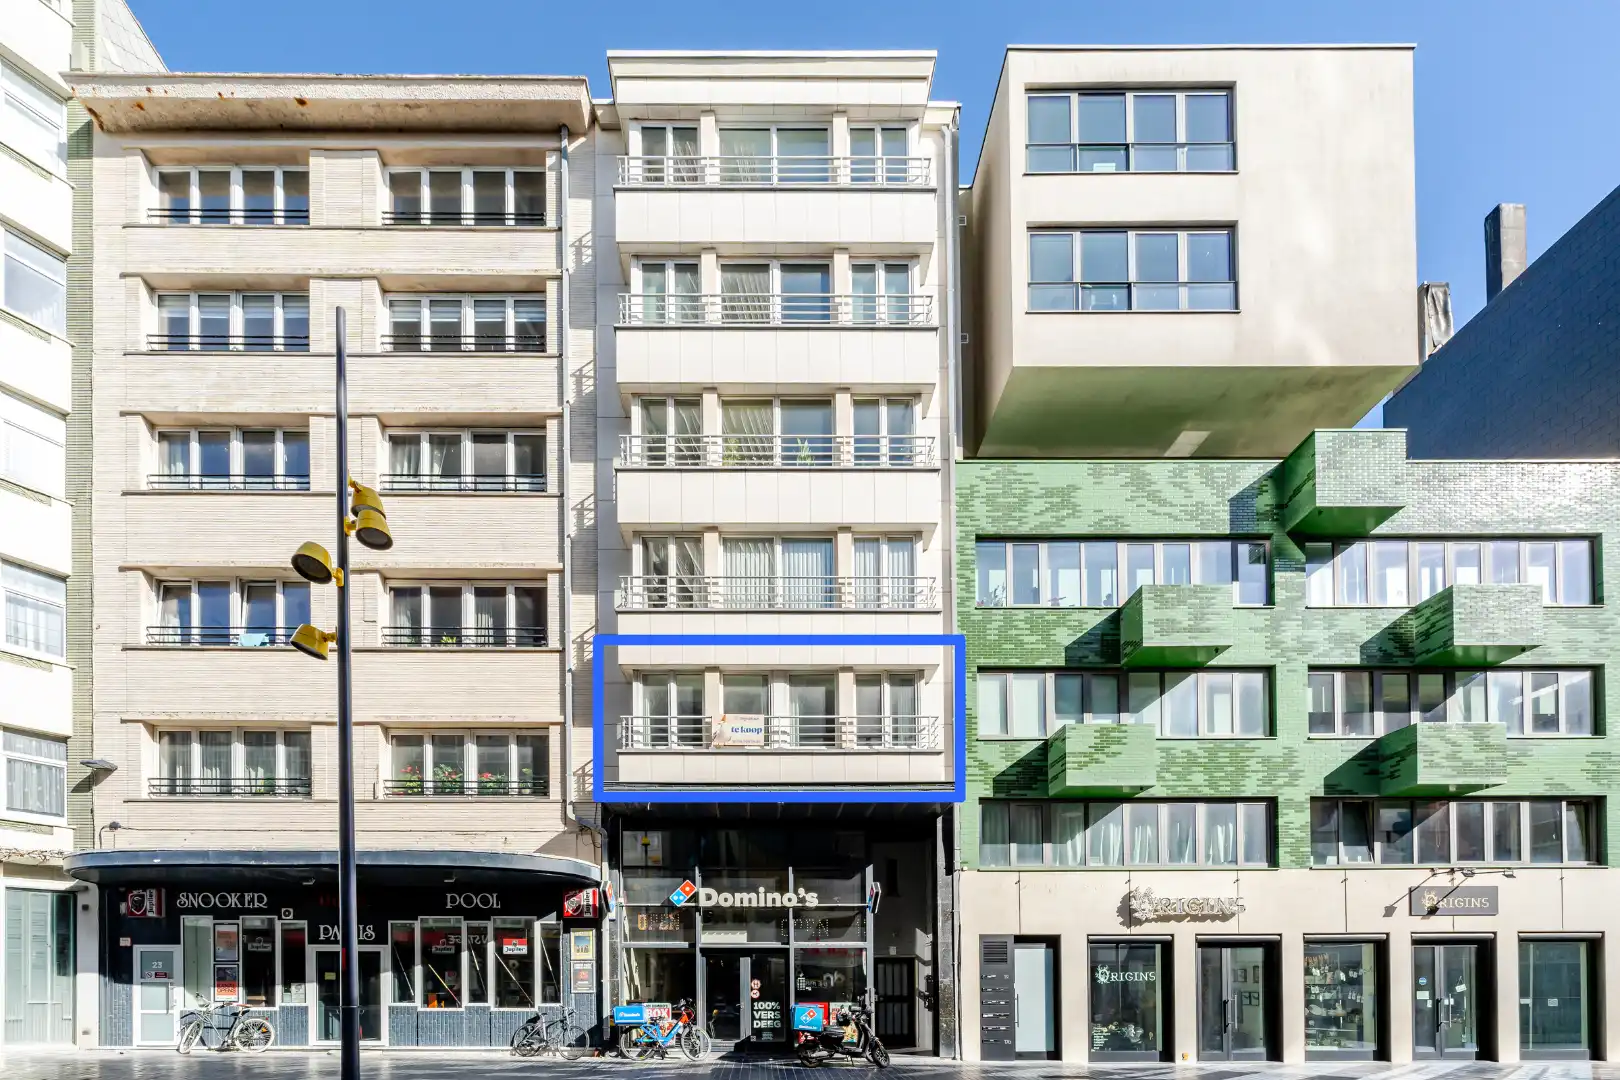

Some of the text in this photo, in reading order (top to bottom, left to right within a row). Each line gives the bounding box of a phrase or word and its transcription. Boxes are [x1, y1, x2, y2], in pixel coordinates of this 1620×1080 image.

[740, 725, 763, 735] koop
[147, 889, 155, 915] Jupiler
[176, 892, 268, 909] SNOOKER
[445, 892, 501, 909] POOL
[584, 890, 592, 916] Jupiler
[698, 886, 819, 908] Domino's
[318, 924, 376, 941] PAIS
[505, 946, 526, 954] Jupiler
[151, 961, 163, 969] 23
[1095, 966, 1156, 983] ORIGINS
[753, 1001, 780, 1010] 100%
[646, 1008, 669, 1020] BOX
[753, 1011, 781, 1019] VERS
[753, 1020, 782, 1028] DEEG
